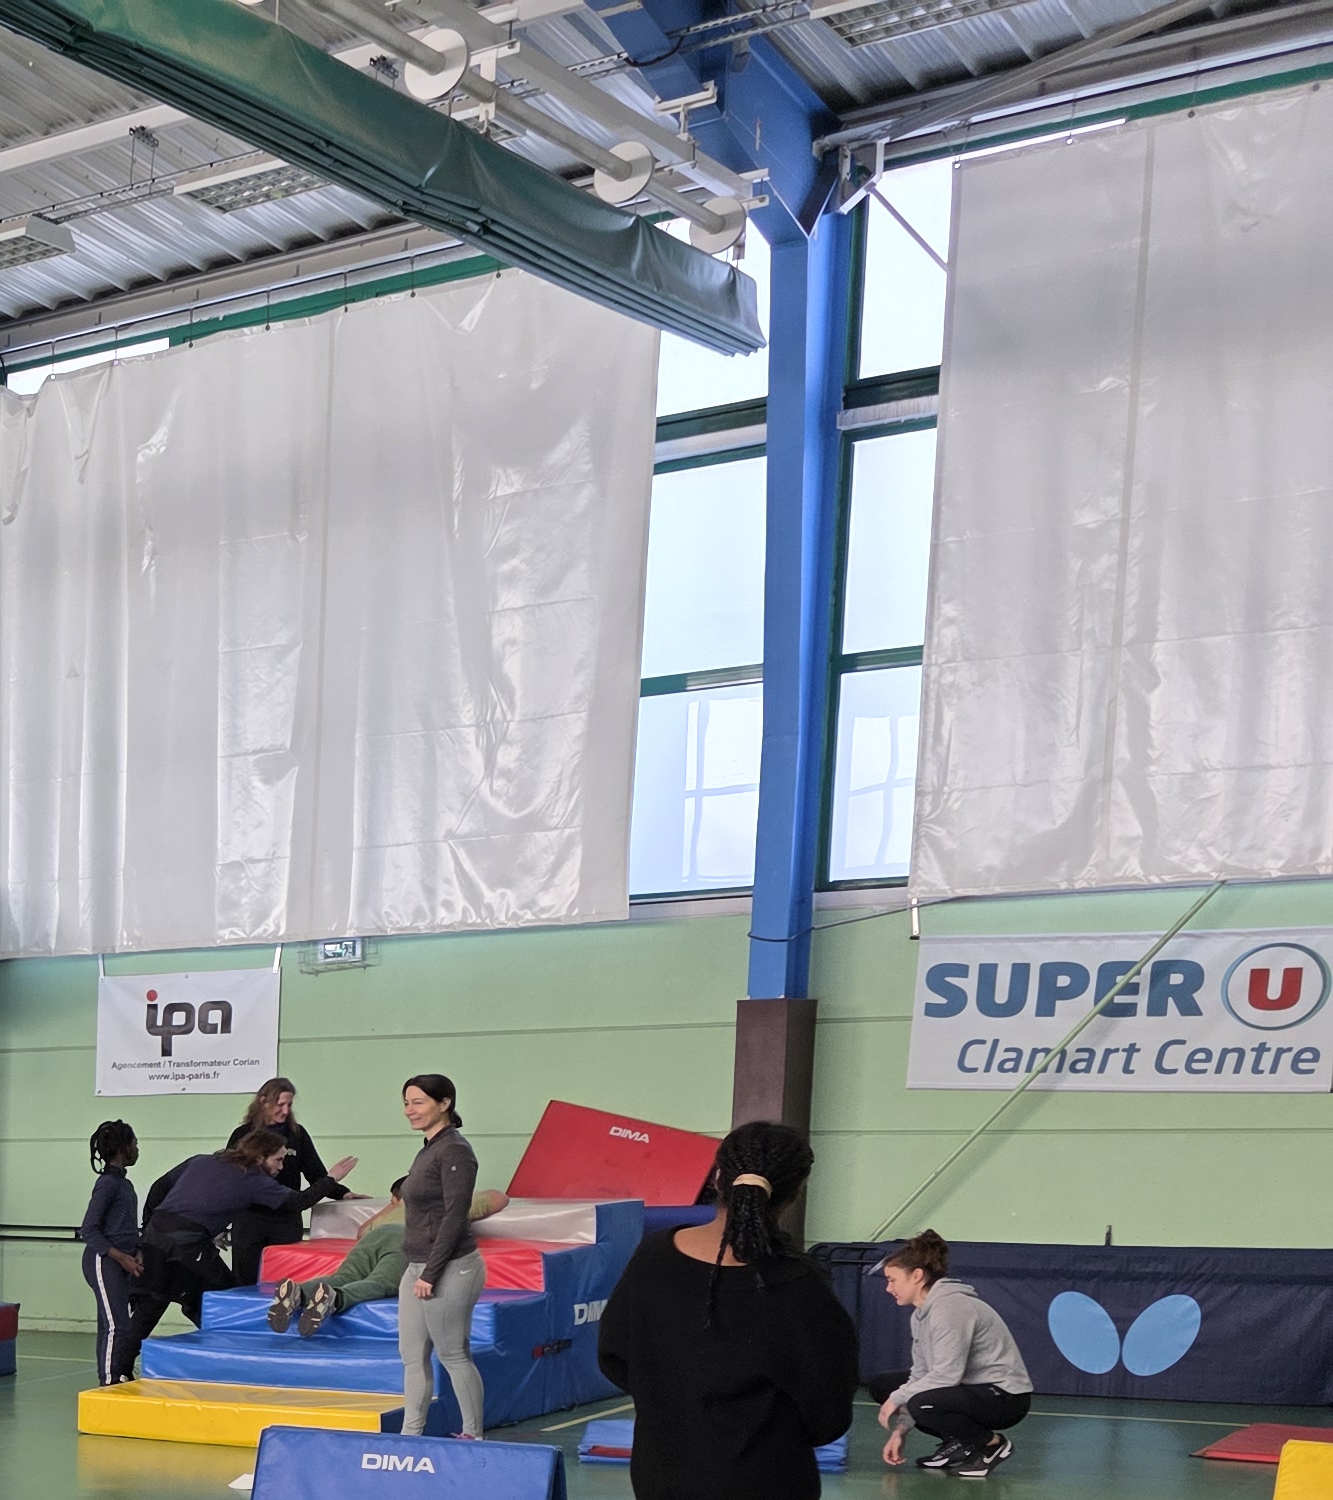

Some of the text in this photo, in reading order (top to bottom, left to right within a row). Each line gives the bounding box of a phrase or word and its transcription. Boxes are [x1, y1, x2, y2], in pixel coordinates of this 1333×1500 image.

[923, 959, 1304, 1018] SUPER U
[145, 989, 233, 1057] ipa
[111, 1060, 162, 1070] Agencement
[167, 1058, 231, 1068] Transformateur
[232, 1057, 261, 1067] Corian
[956, 1038, 1321, 1075] Clamart Centre
[148, 1070, 221, 1081] www.ipa-paris.fr
[609, 1126, 650, 1143] DIMA
[361, 1453, 435, 1475] DIMA
